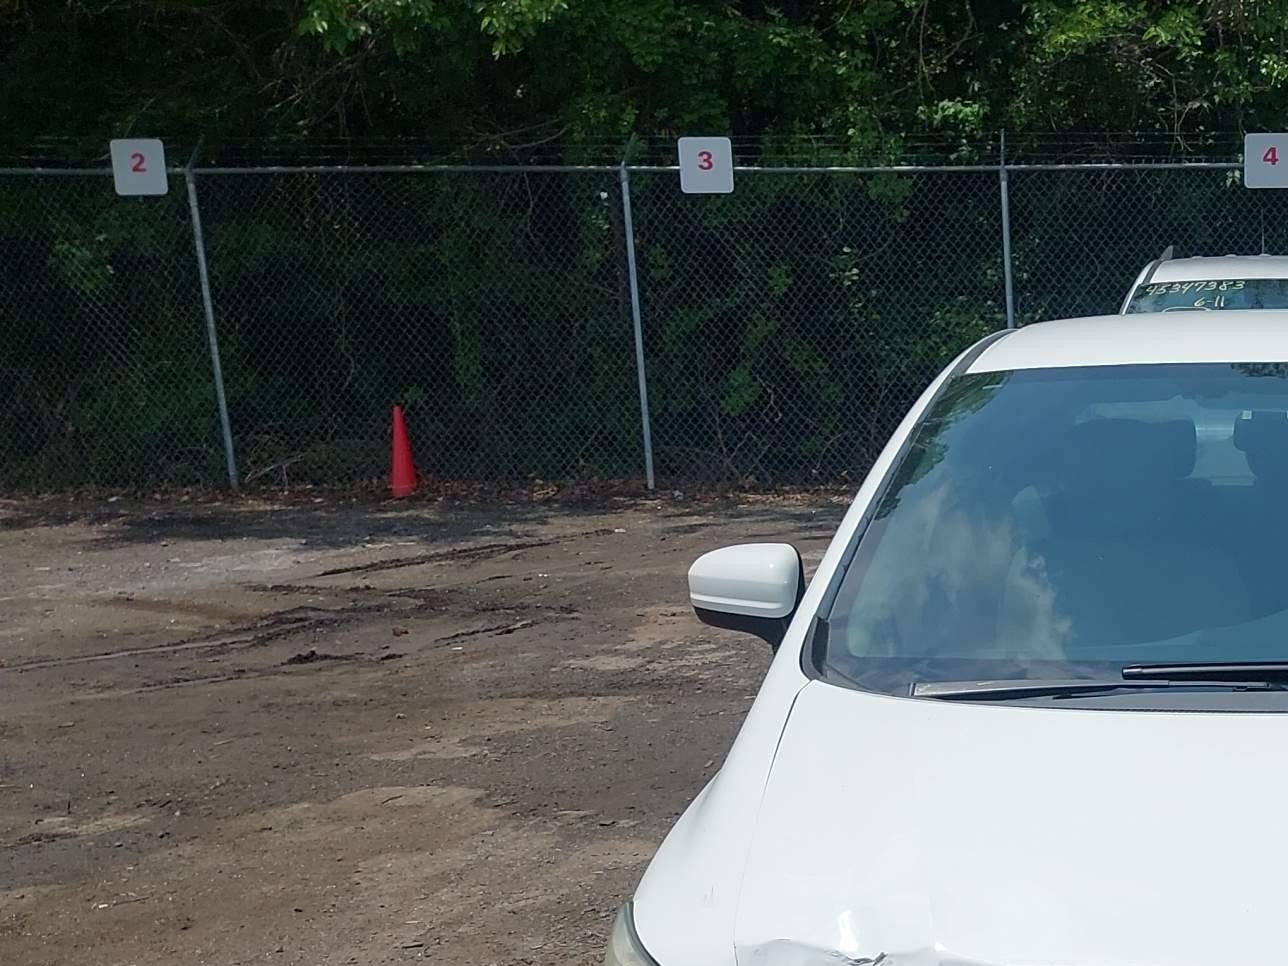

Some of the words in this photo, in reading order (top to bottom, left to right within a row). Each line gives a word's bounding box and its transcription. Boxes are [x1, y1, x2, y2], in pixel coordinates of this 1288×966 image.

[131, 153, 147, 172] 2
[697, 152, 714, 171] 3
[1262, 147, 1280, 165] 4
[1145, 280, 1246, 296] 45347383
[1194, 295, 1225, 308] 6-11
